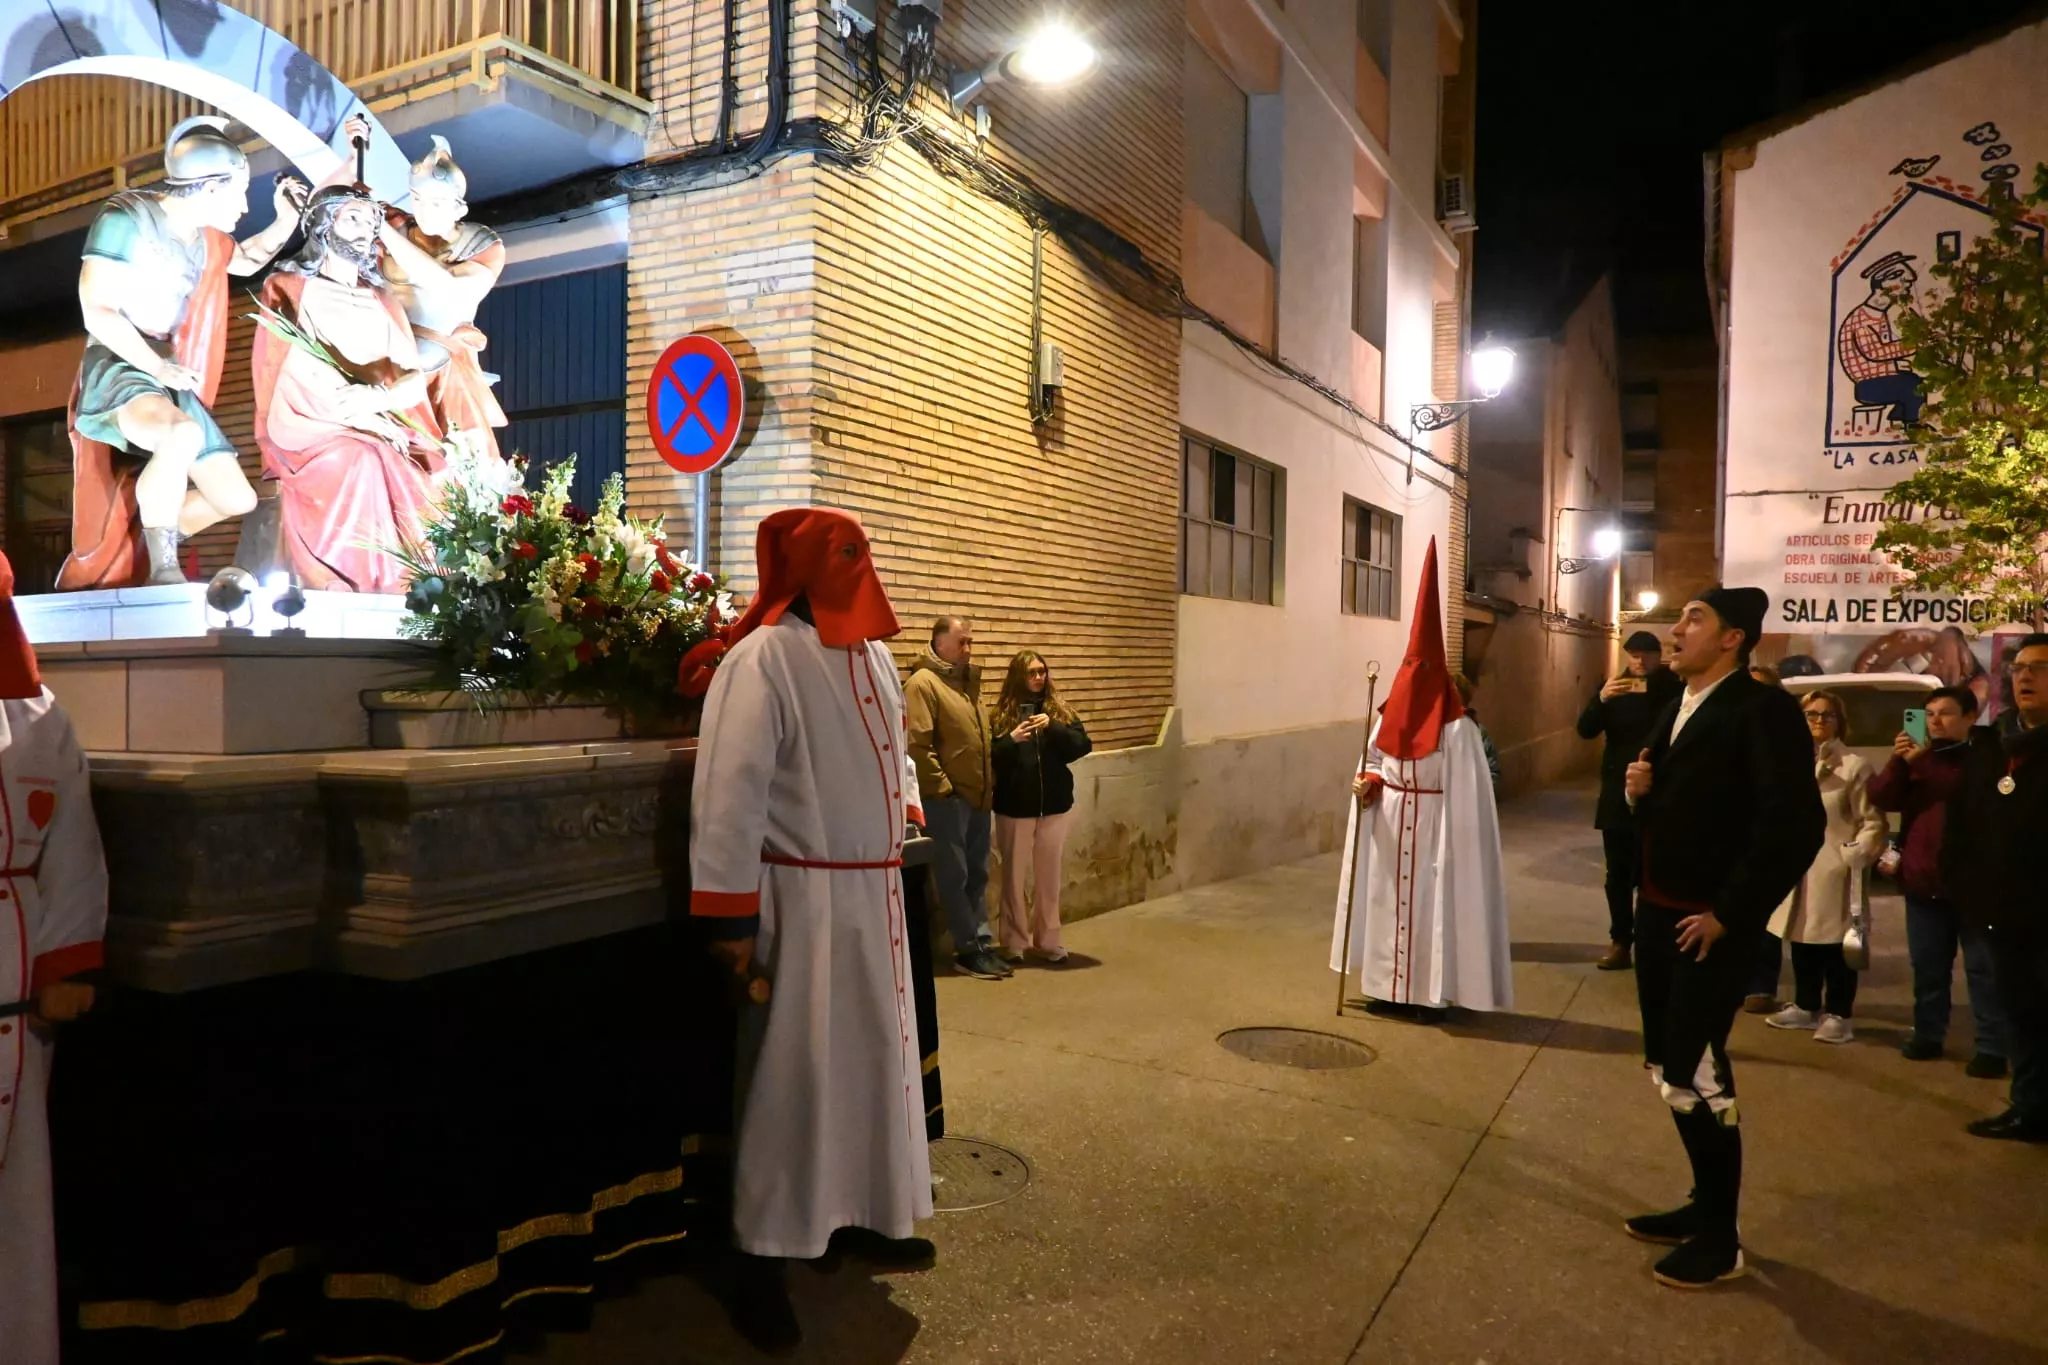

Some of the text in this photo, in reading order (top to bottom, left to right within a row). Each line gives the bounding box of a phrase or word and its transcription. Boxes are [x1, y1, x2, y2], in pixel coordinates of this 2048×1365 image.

[1868, 449, 1919, 465] CASA
[1786, 534, 1850, 547] ARTICULOS
[1785, 553, 1816, 566] OBRA
[1784, 571, 1909, 584] ESCUELA DE ARTES
[1782, 598, 1839, 623] SALA
[1846, 599, 1877, 622] DE
